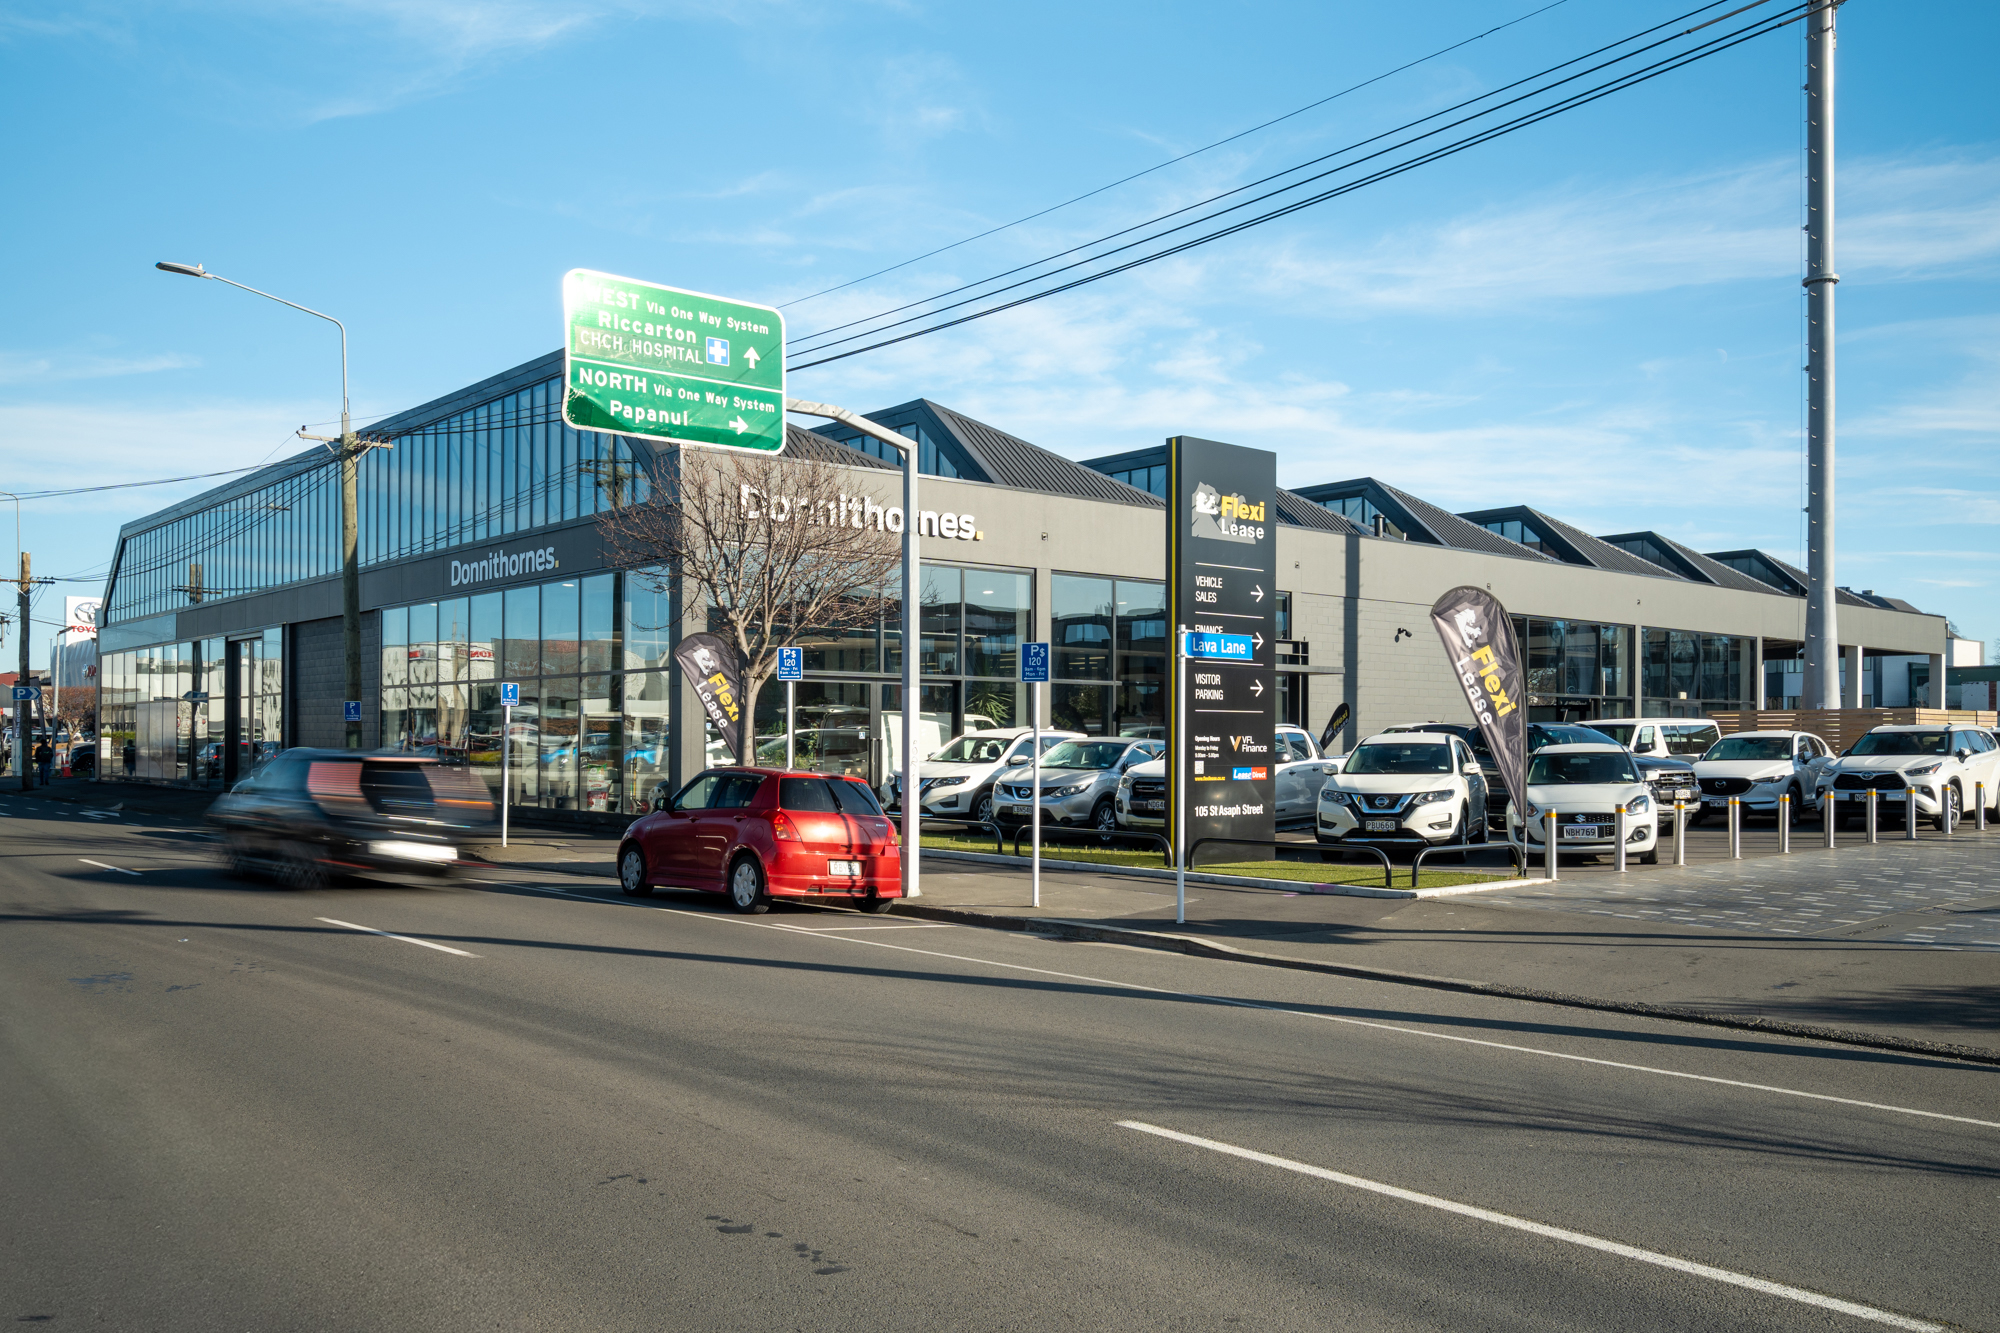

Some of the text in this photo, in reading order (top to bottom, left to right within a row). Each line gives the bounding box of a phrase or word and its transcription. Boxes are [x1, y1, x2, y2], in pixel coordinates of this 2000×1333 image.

[646, 301, 665, 315] Via
[671, 306, 693, 321] One
[699, 311, 721, 329] Way
[727, 317, 769, 335] System
[599, 311, 697, 343] Riccarton
[580, 330, 704, 364] CHCH HOSPITAL
[579, 367, 775, 413] NORTH Via One Way System
[610, 400, 688, 426] Papanui
[740, 484, 983, 541] Donnithones.
[1221, 495, 1265, 522] Flexi
[1221, 518, 1265, 539] Lease
[1195, 575, 1223, 588] VEHICLE
[1195, 590, 1217, 603] SALES
[1193, 637, 1246, 654] Lava Lane
[1029, 657, 1041, 665] 120
[1195, 673, 1221, 685] VISITOR
[1470, 644, 1517, 718] Flexi
[17, 689, 25, 698] P
[1195, 688, 1223, 700] PARKING
[1456, 656, 1493, 726] Lease
[695, 681, 728, 728] Lease
[1242, 736, 1254, 744] VFL
[1242, 744, 1268, 752] Finance
[1233, 769, 1252, 779] Lease
[1195, 803, 1263, 818] 105 St Asaph Street
[1565, 828, 1596, 837] NBH769
